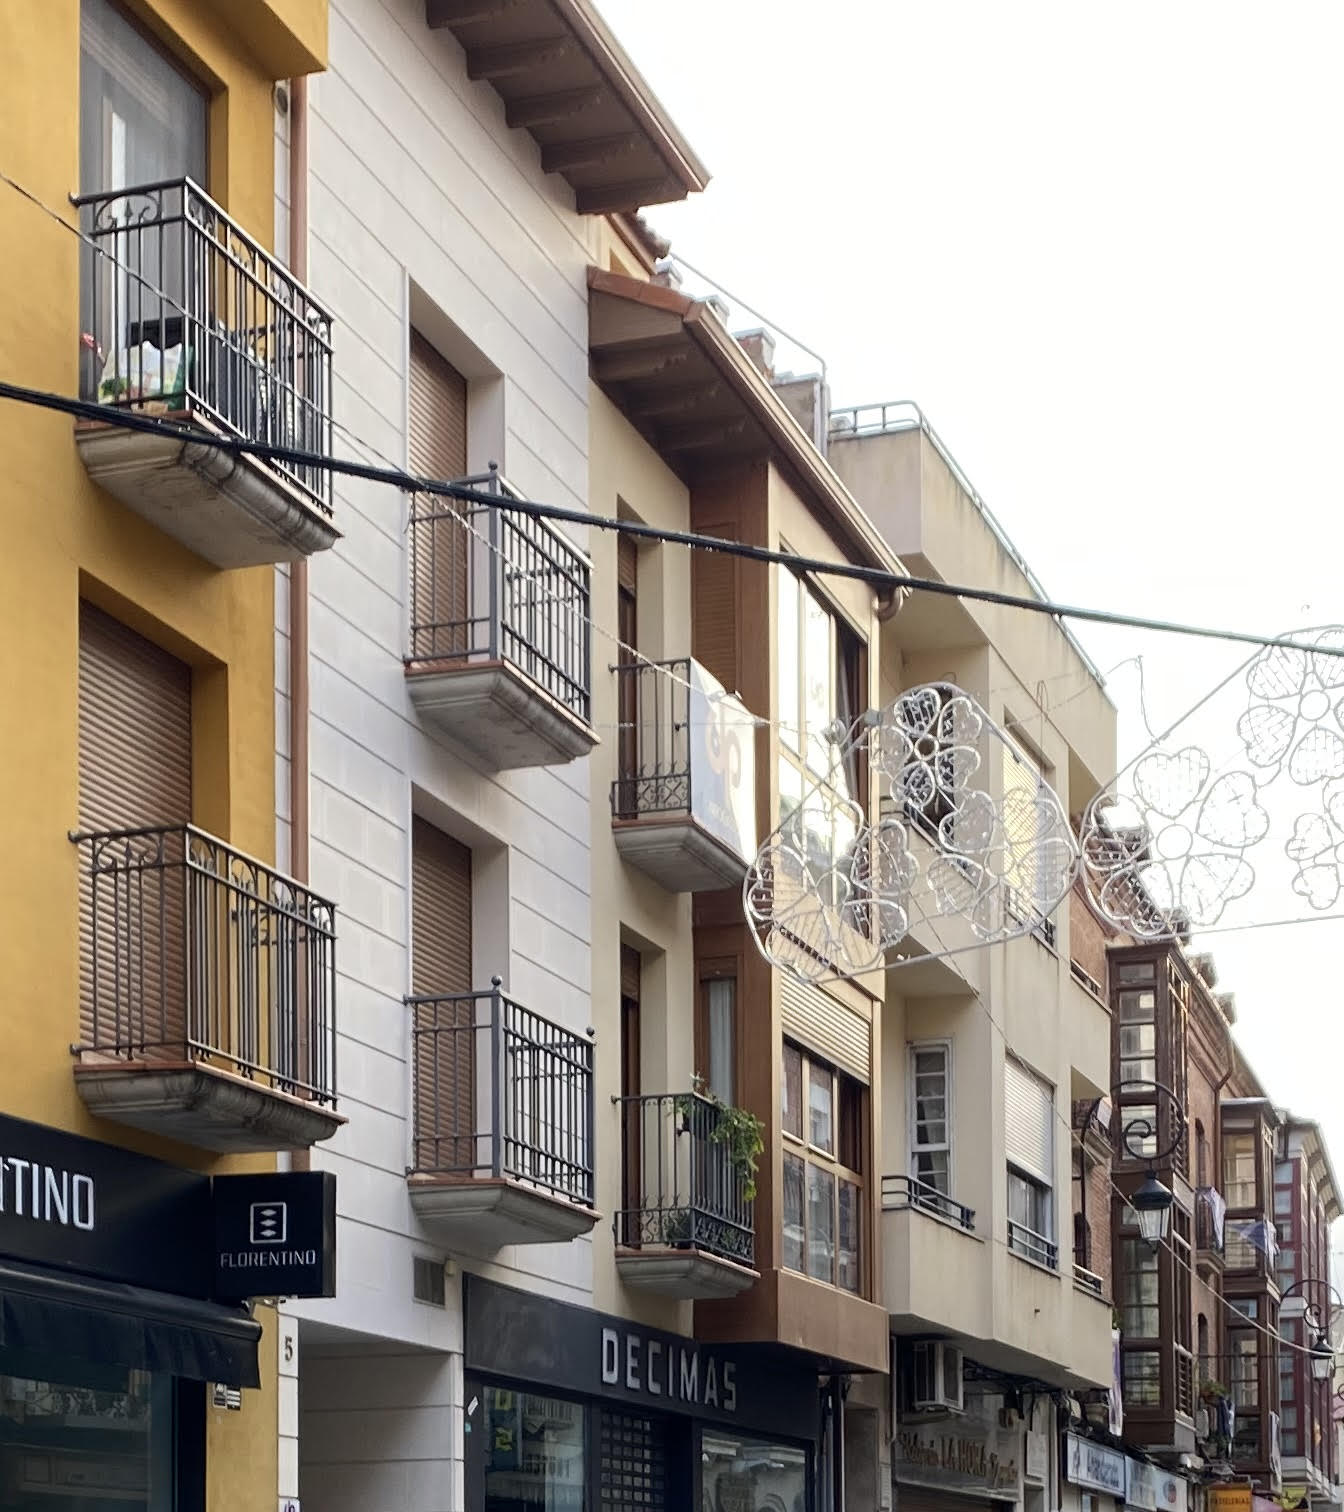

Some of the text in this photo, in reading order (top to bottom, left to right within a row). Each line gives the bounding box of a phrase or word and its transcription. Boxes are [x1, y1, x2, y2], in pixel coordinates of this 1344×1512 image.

[220, 1249, 316, 1268] FLORENTINO
[284, 1336, 294, 1362] 5
[602, 1327, 737, 1412] DECIMAS
